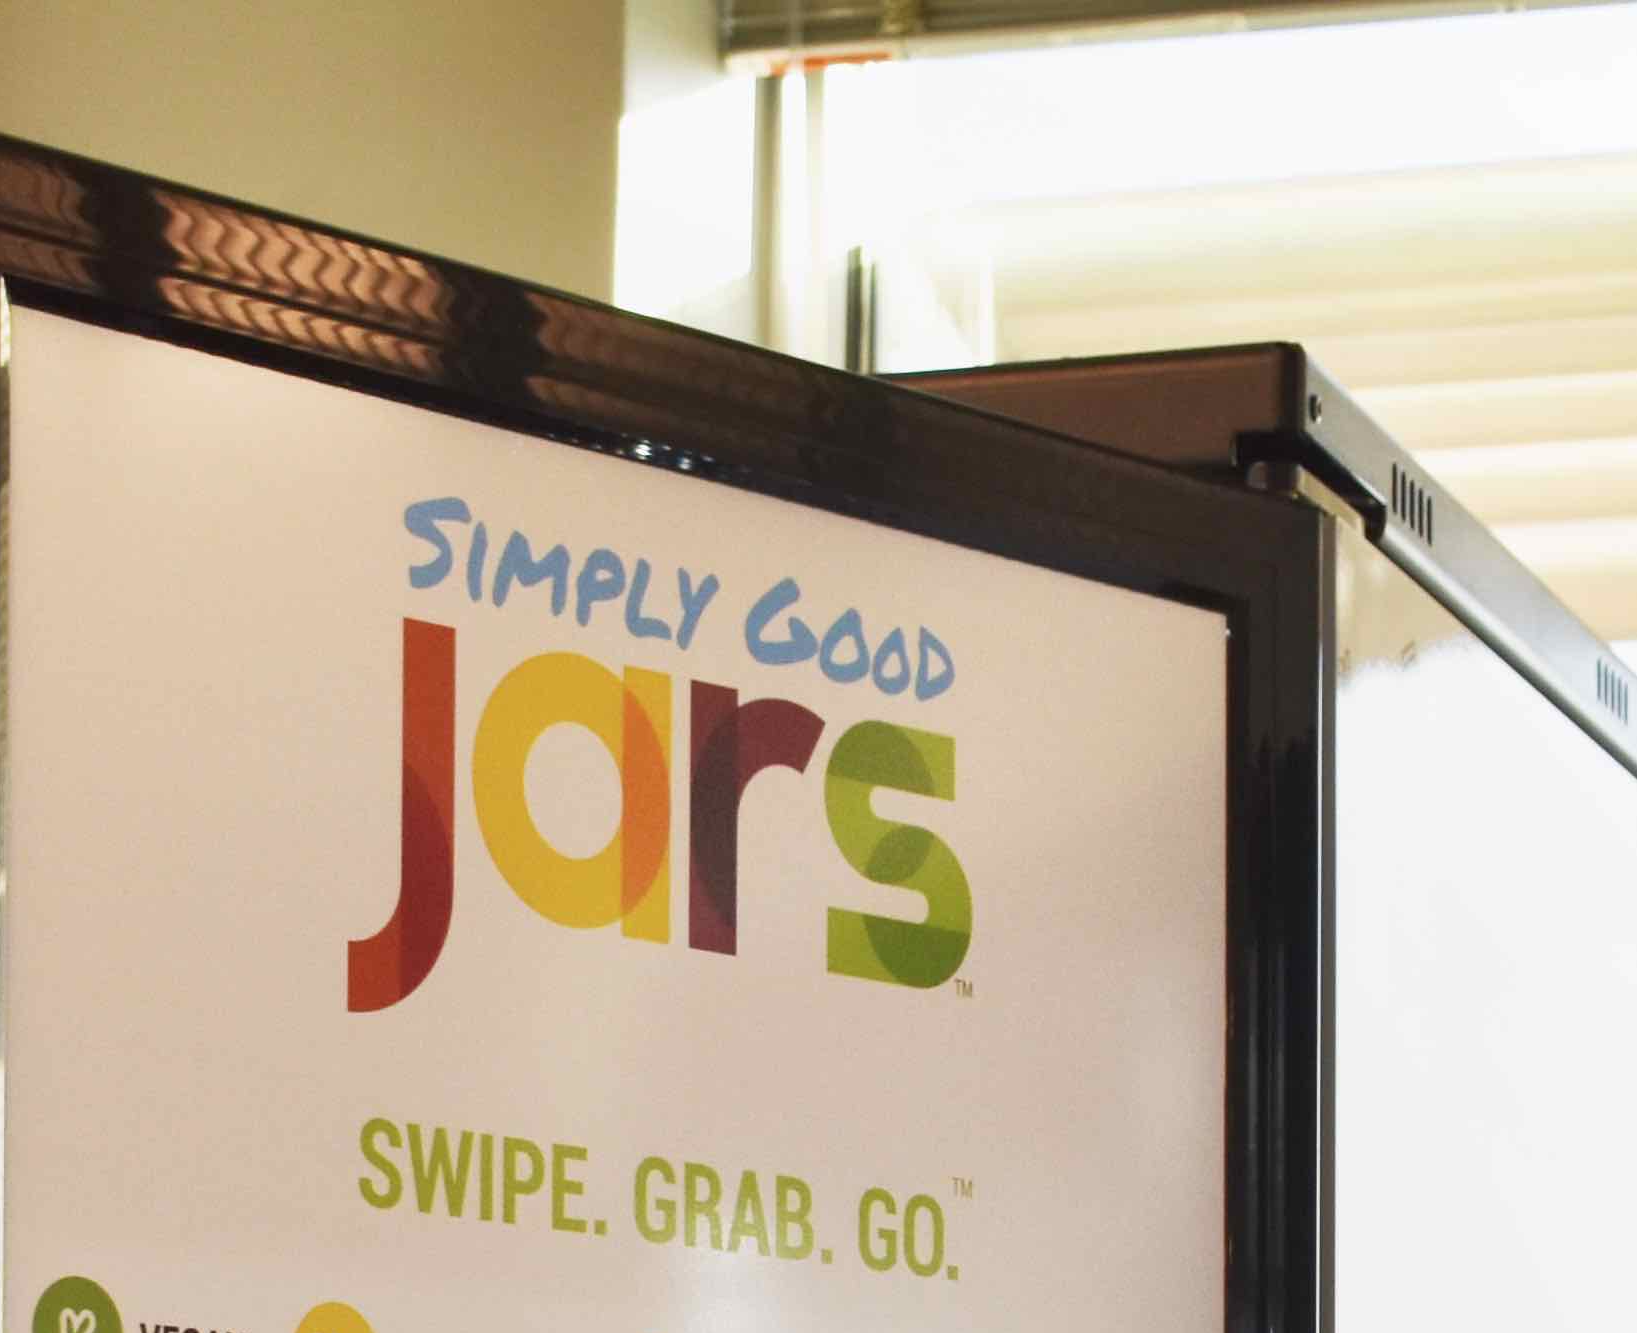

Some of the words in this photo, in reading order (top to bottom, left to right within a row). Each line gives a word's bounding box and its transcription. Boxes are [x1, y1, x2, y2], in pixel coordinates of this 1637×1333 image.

[404, 497, 719, 650] SIMPLY
[745, 578, 955, 700] GOOD
[358, 1117, 607, 1236] SWIPE.
[633, 1155, 832, 1264] GRAB.
[858, 1186, 959, 1280] GO.
